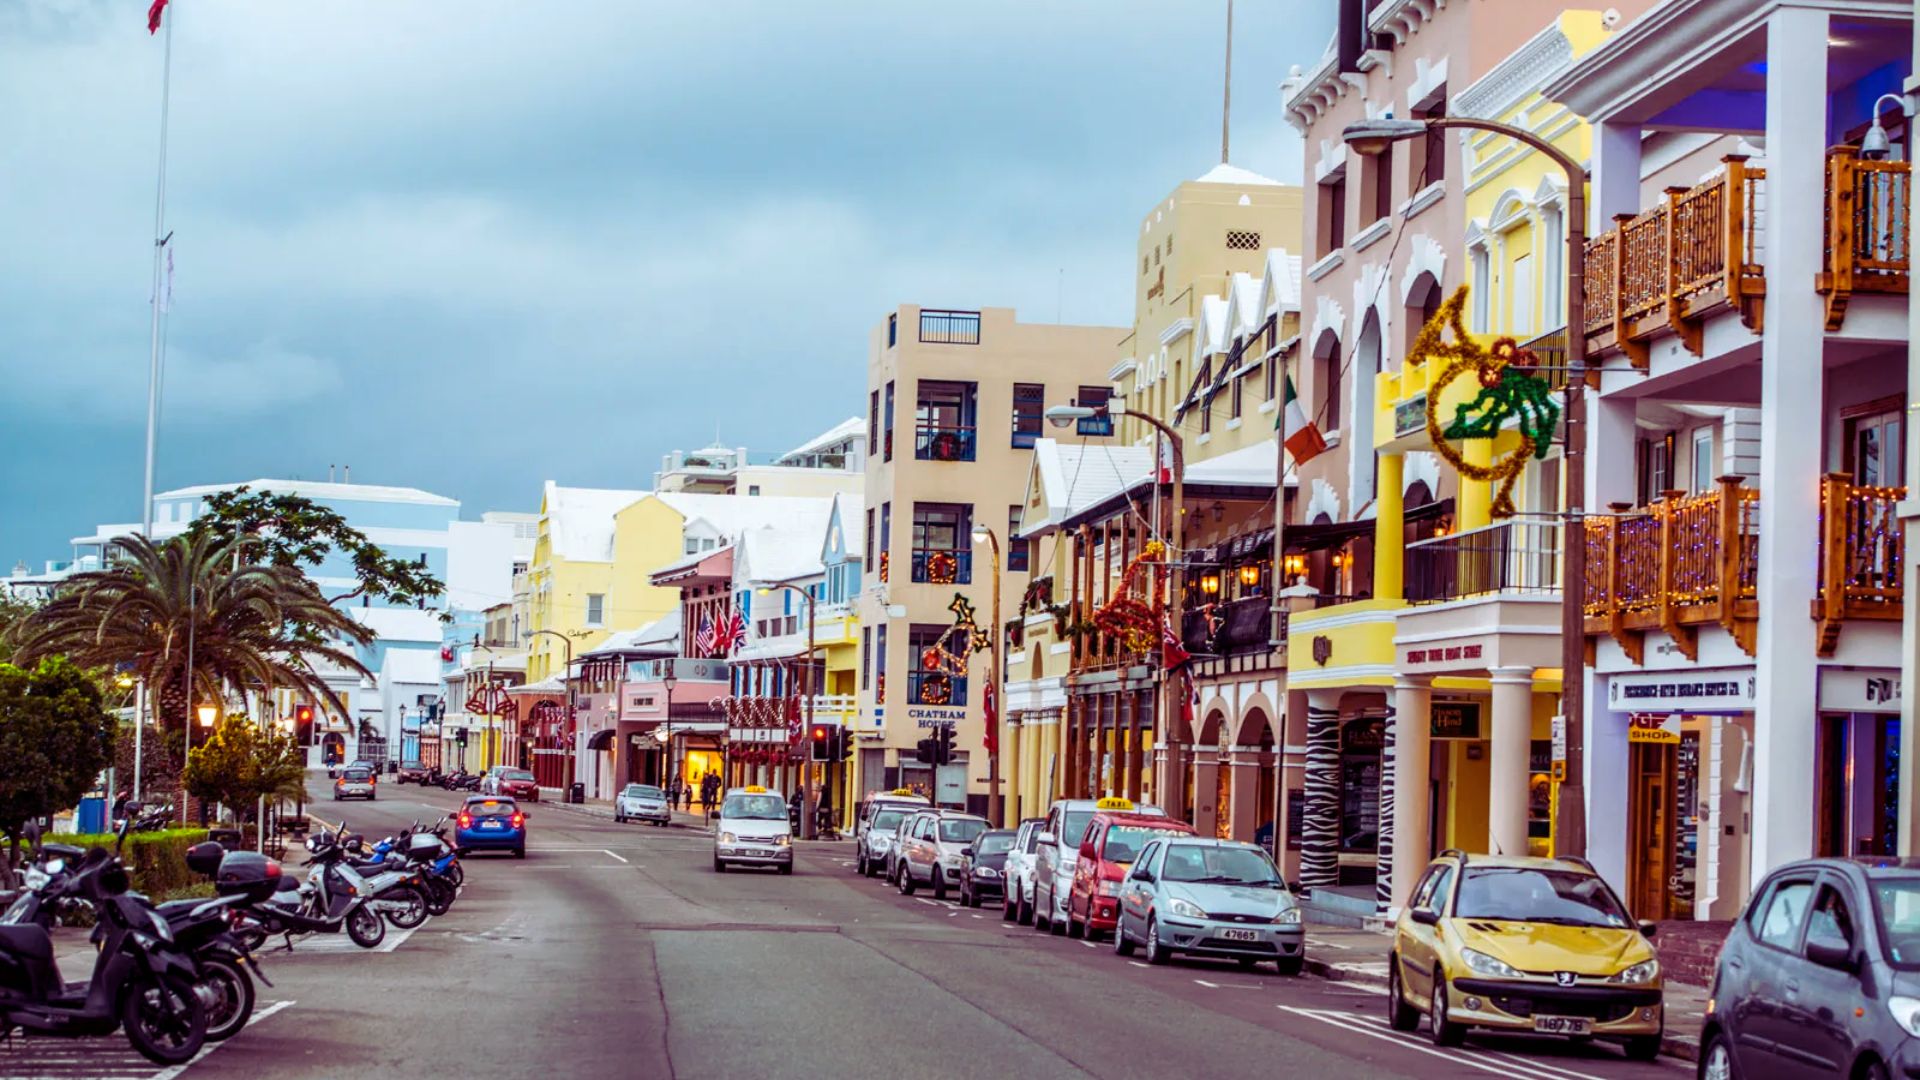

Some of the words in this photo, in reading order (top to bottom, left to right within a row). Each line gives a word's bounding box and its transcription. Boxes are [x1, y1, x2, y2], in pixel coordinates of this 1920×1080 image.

[908, 709, 966, 719] CHATHAM
[918, 719, 956, 729] HOUSE
[1632, 731, 1671, 739] SHOP
[1106, 800, 1126, 808] TAXI
[1224, 929, 1255, 940] 47665
